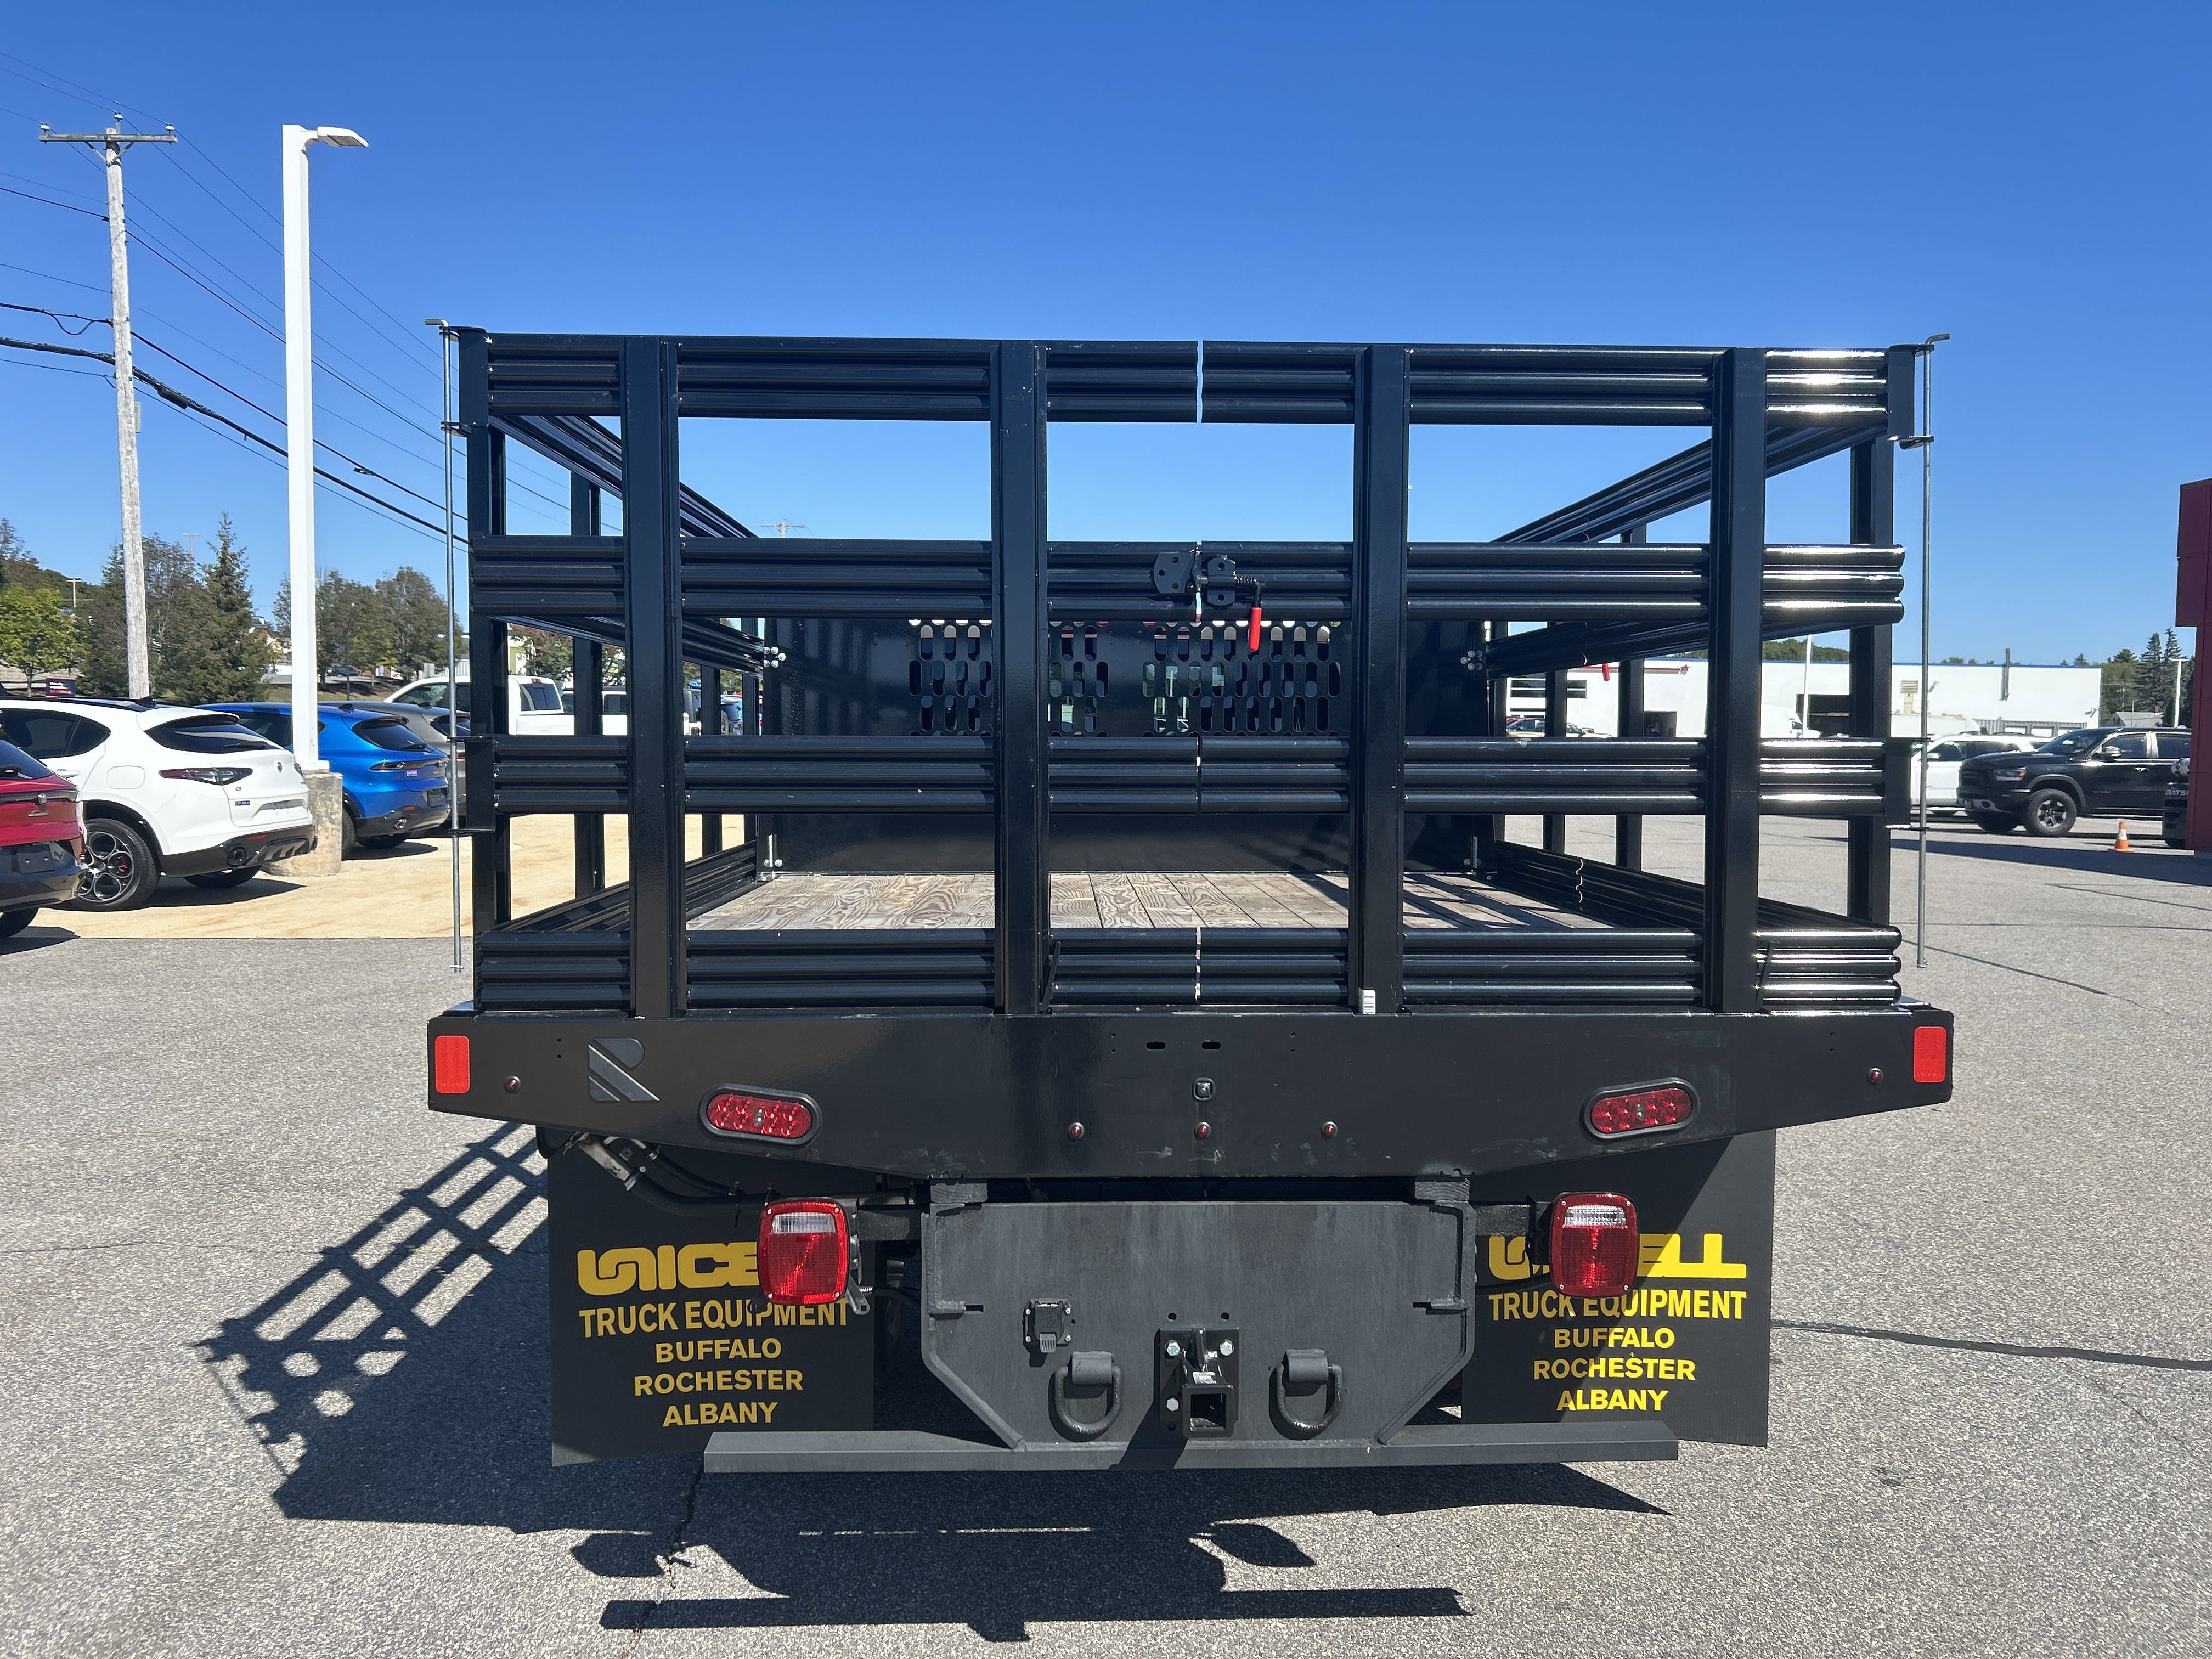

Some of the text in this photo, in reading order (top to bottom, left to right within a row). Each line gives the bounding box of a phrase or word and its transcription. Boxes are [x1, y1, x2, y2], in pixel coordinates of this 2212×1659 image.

[578, 1242, 759, 1296] UNICE
[579, 1298, 848, 1337] TRUCK EQUIPMENT
[1488, 1289, 1747, 1321] TRUCK EQUIPMENT
[655, 1338, 782, 1363] BUFFALO
[1554, 1327, 1676, 1349] BUFFALO
[1534, 1357, 1696, 1381] ROCHESTER
[635, 1369, 804, 1396] ROCHESTER
[1556, 1389, 1669, 1412] ALBANY
[662, 1402, 778, 1426] ALBANY
